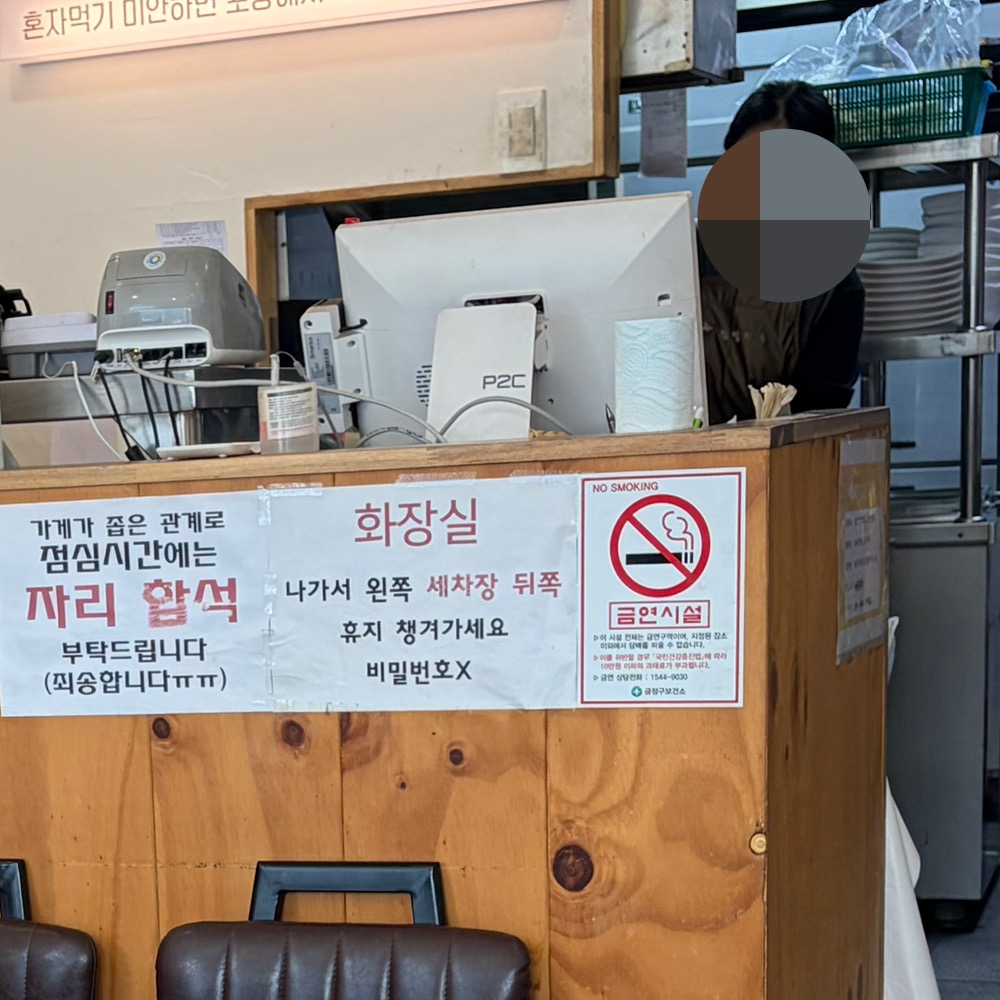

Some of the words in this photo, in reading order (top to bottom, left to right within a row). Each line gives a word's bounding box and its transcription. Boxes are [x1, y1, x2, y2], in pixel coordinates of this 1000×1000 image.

[22, 1, 114, 40] 혼자먹기
[482, 374, 526, 389] P2C
[592, 483, 607, 493] NO
[610, 482, 659, 492] SMOKING
[30, 517, 94, 540] 가게가
[105, 513, 148, 536] 좁은
[160, 511, 226, 534] 관계로
[354, 498, 478, 547] 화장실
[40, 540, 217, 574] 점심시간에는
[286, 578, 351, 602] 나가서
[365, 576, 413, 603] 왼쪽
[426, 573, 498, 601] 세차장
[512, 571, 562, 598] 뒤쪽
[26, 582, 117, 629] 자리
[143, 578, 238, 629] 합석
[617, 605, 702, 625] 금연시설
[340, 620, 382, 643] 휴지
[396, 617, 509, 645] 챙겨가세요
[62, 638, 207, 664] 부탁드립니다
[44, 667, 227, 695] (죄송합니다ㅠㅠ)
[366, 659, 472, 685] 비밀번호X
[650, 673, 688, 681] 1544-9030
